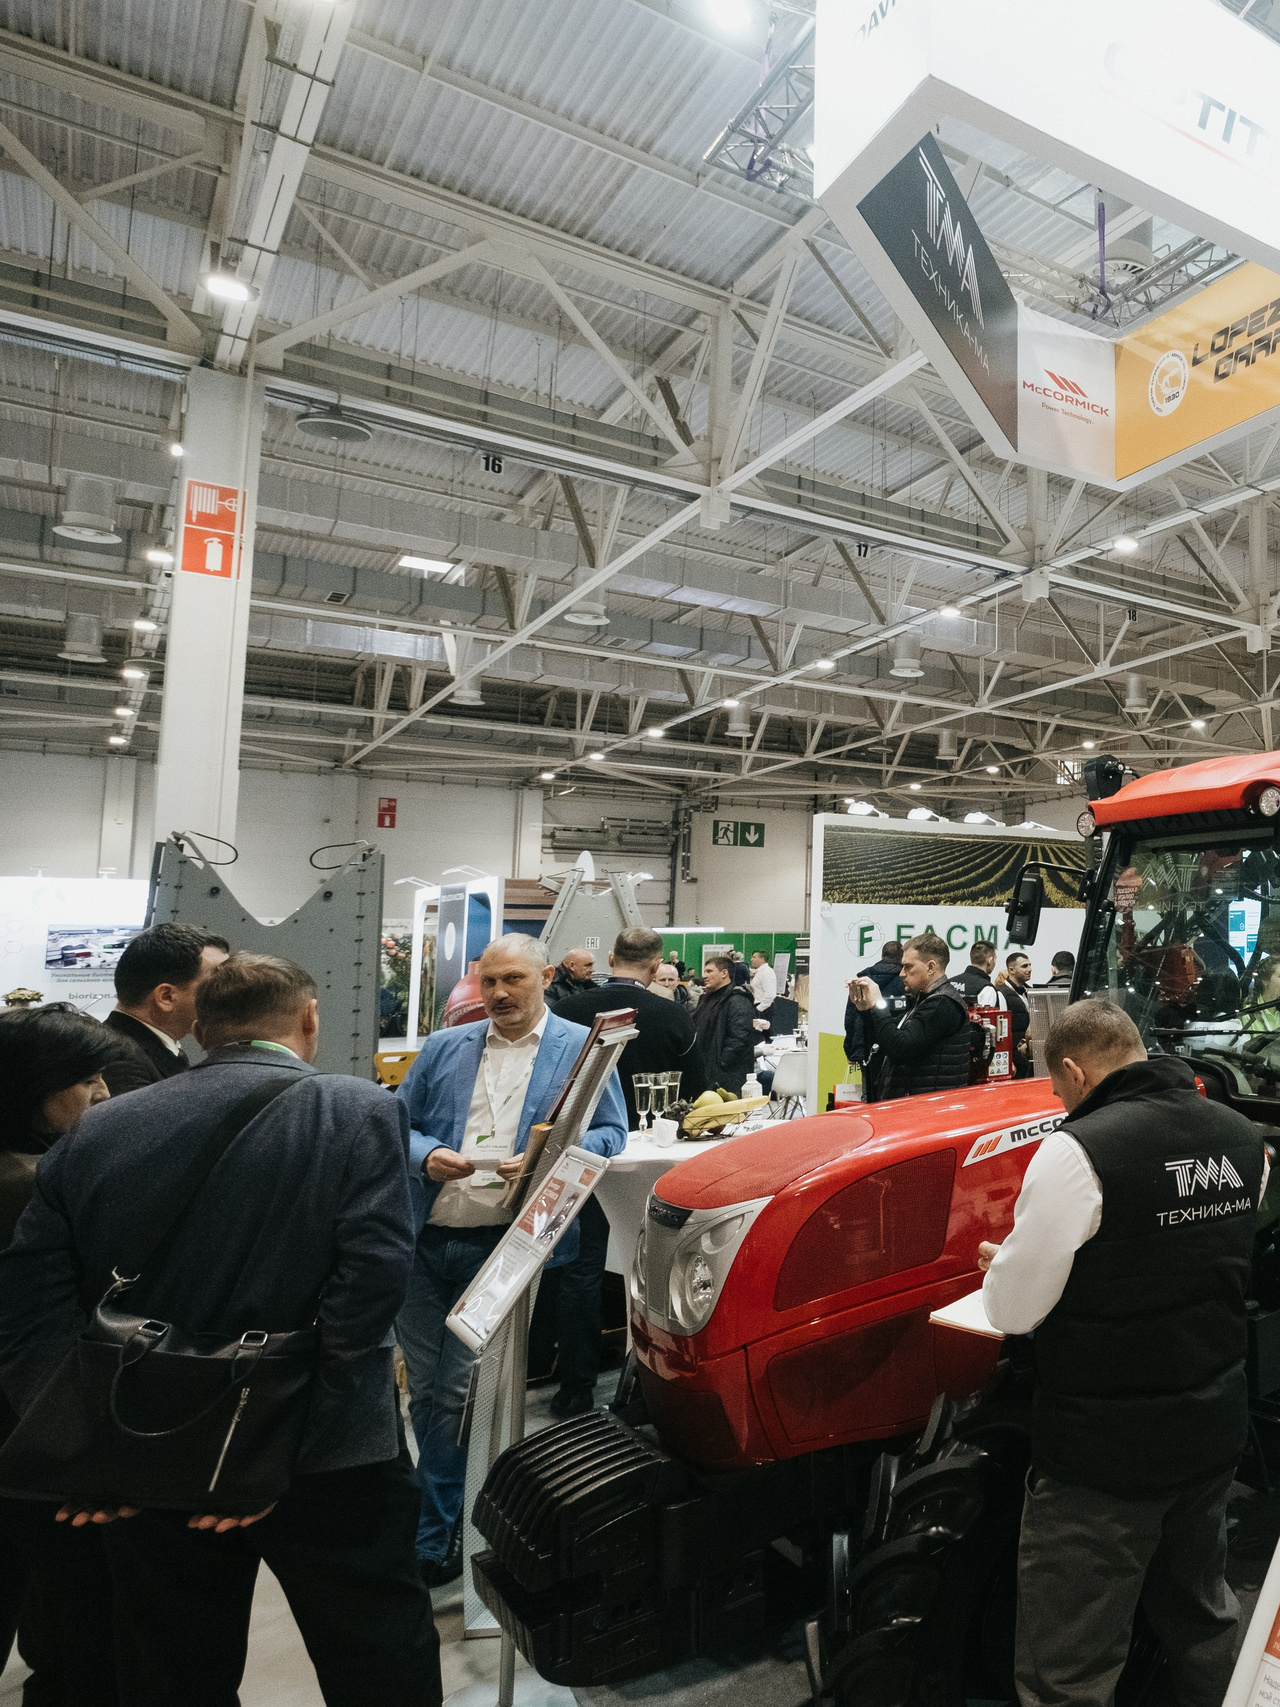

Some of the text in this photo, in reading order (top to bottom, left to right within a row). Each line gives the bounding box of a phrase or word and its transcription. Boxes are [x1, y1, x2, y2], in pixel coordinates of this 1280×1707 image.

[911, 229, 990, 376] ТЕХНИКА-МА
[1022, 380, 1109, 417] McCORMICK
[1041, 402, 1060, 414] Power
[482, 456, 502, 473] 16
[857, 543, 868, 557] 17
[1128, 609, 1136, 621] 18
[1156, 1197, 1252, 1226] ТЕХНИКА-МА
